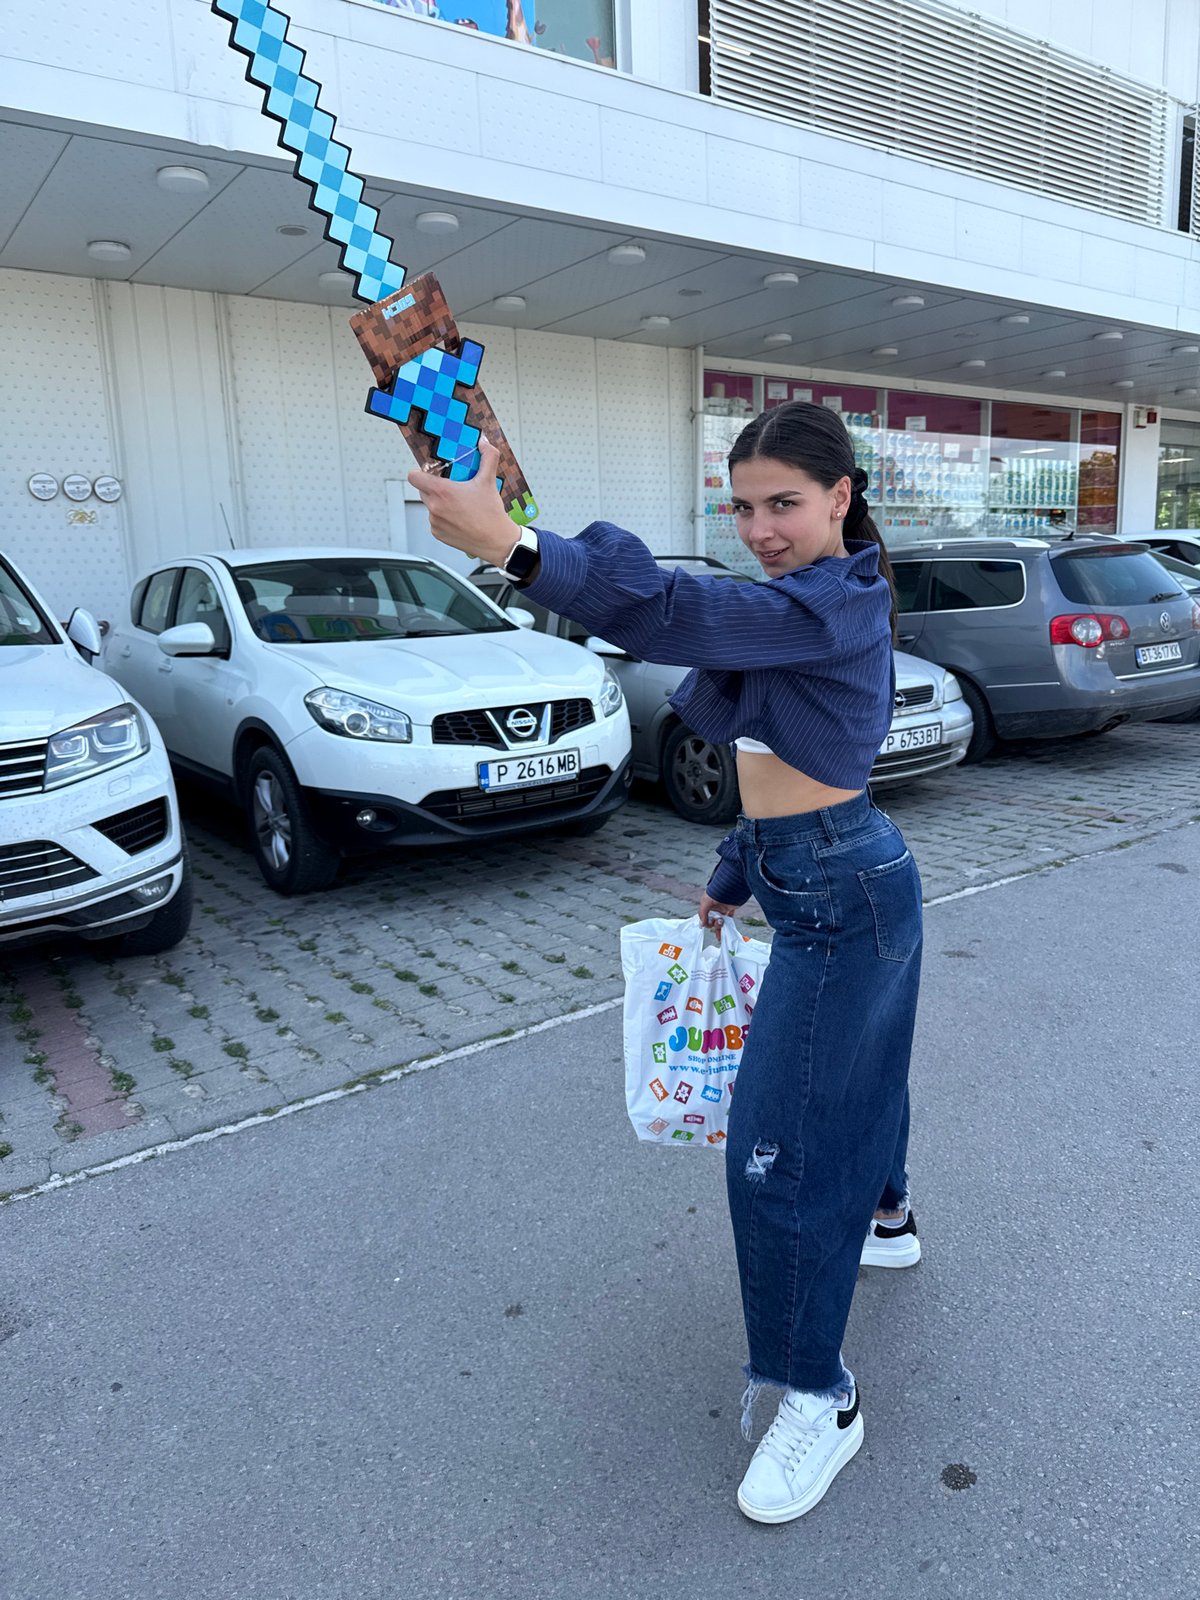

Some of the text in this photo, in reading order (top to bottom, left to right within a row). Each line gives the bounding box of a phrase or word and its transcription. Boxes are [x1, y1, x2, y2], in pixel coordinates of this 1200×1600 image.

[511, 718, 535, 726] NISSAN
[688, 1053, 736, 1064] SHOP ONLINE
